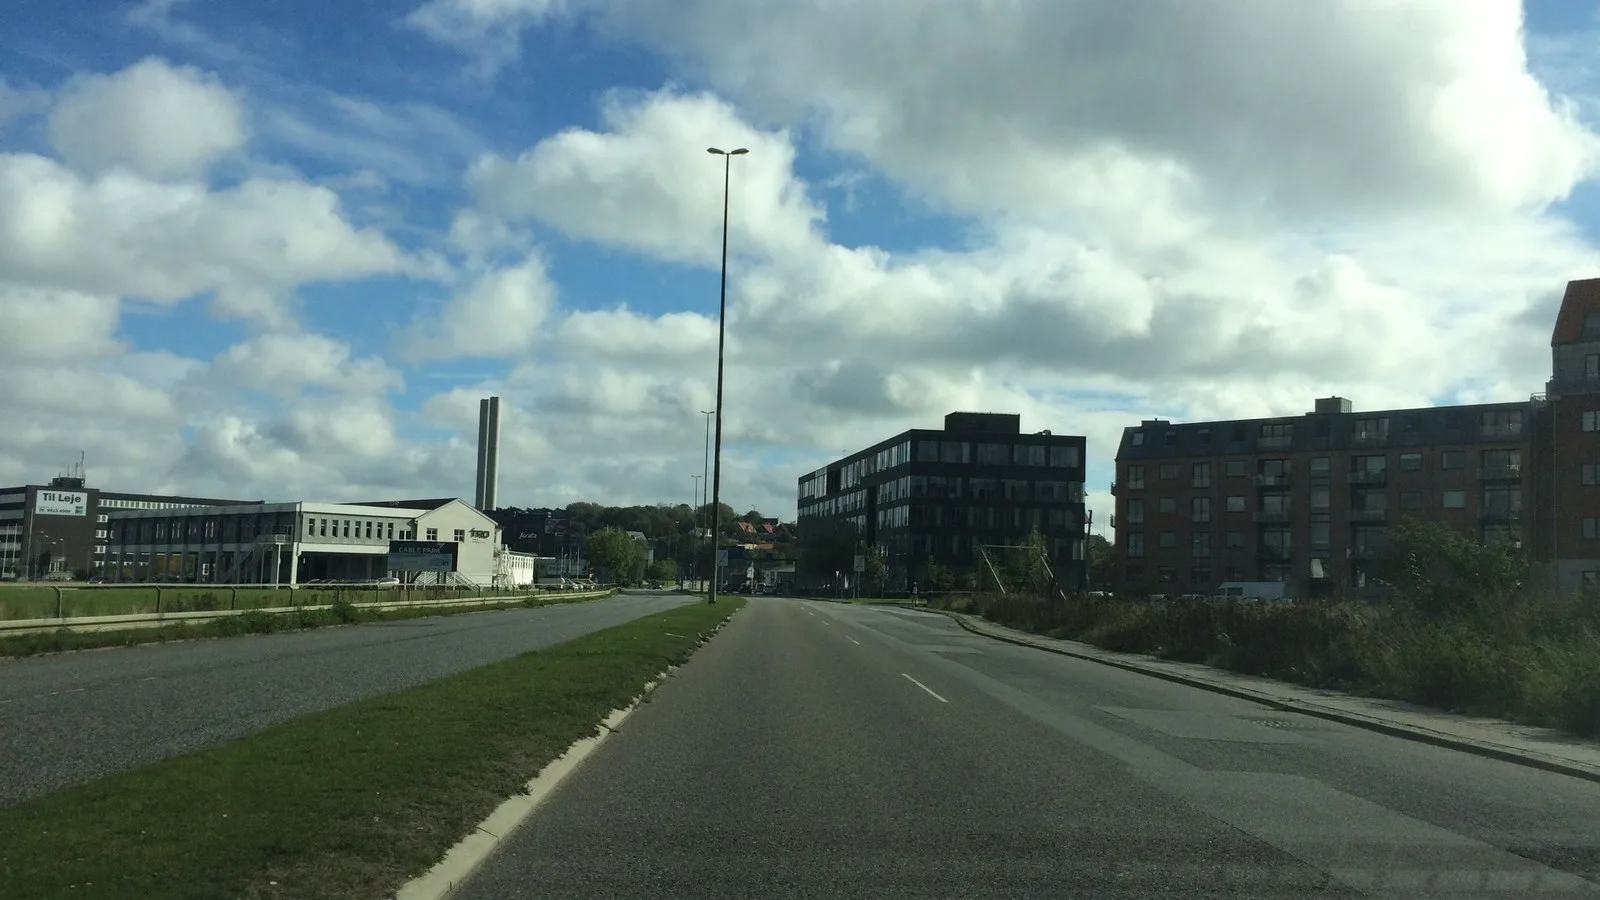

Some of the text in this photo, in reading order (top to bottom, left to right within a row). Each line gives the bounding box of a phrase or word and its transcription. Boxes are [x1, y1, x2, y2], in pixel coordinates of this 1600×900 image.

[43, 492, 81, 504] Til Leje
[423, 546, 442, 554] PARK
